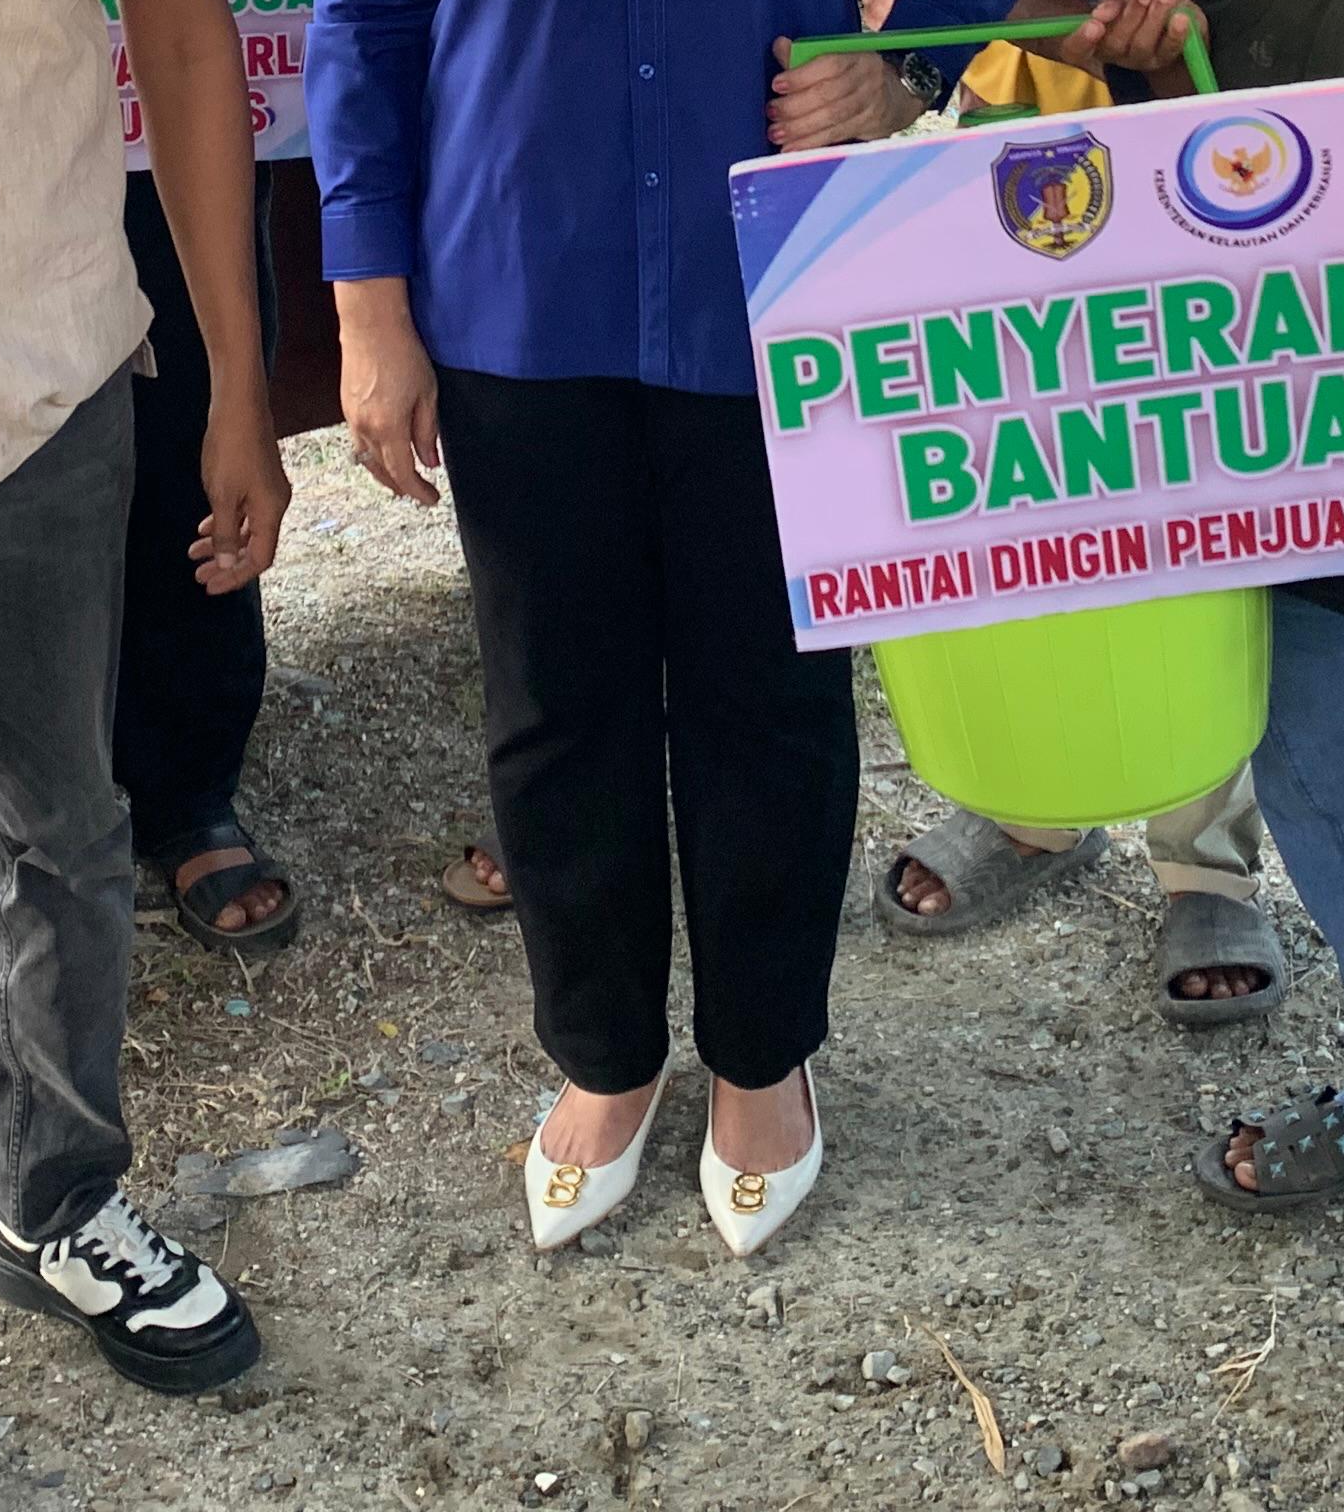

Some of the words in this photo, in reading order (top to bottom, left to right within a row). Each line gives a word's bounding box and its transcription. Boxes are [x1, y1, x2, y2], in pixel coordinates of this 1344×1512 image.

[1154, 169, 1208, 239] KEMENTERIAN
[1209, 232, 1277, 248] KELAUTAN
[1278, 215, 1306, 236] DAN
[1305, 148, 1333, 216] PERIKANAN
[807, 551, 975, 621] RANTAI
[989, 524, 1149, 591] DINGIN
